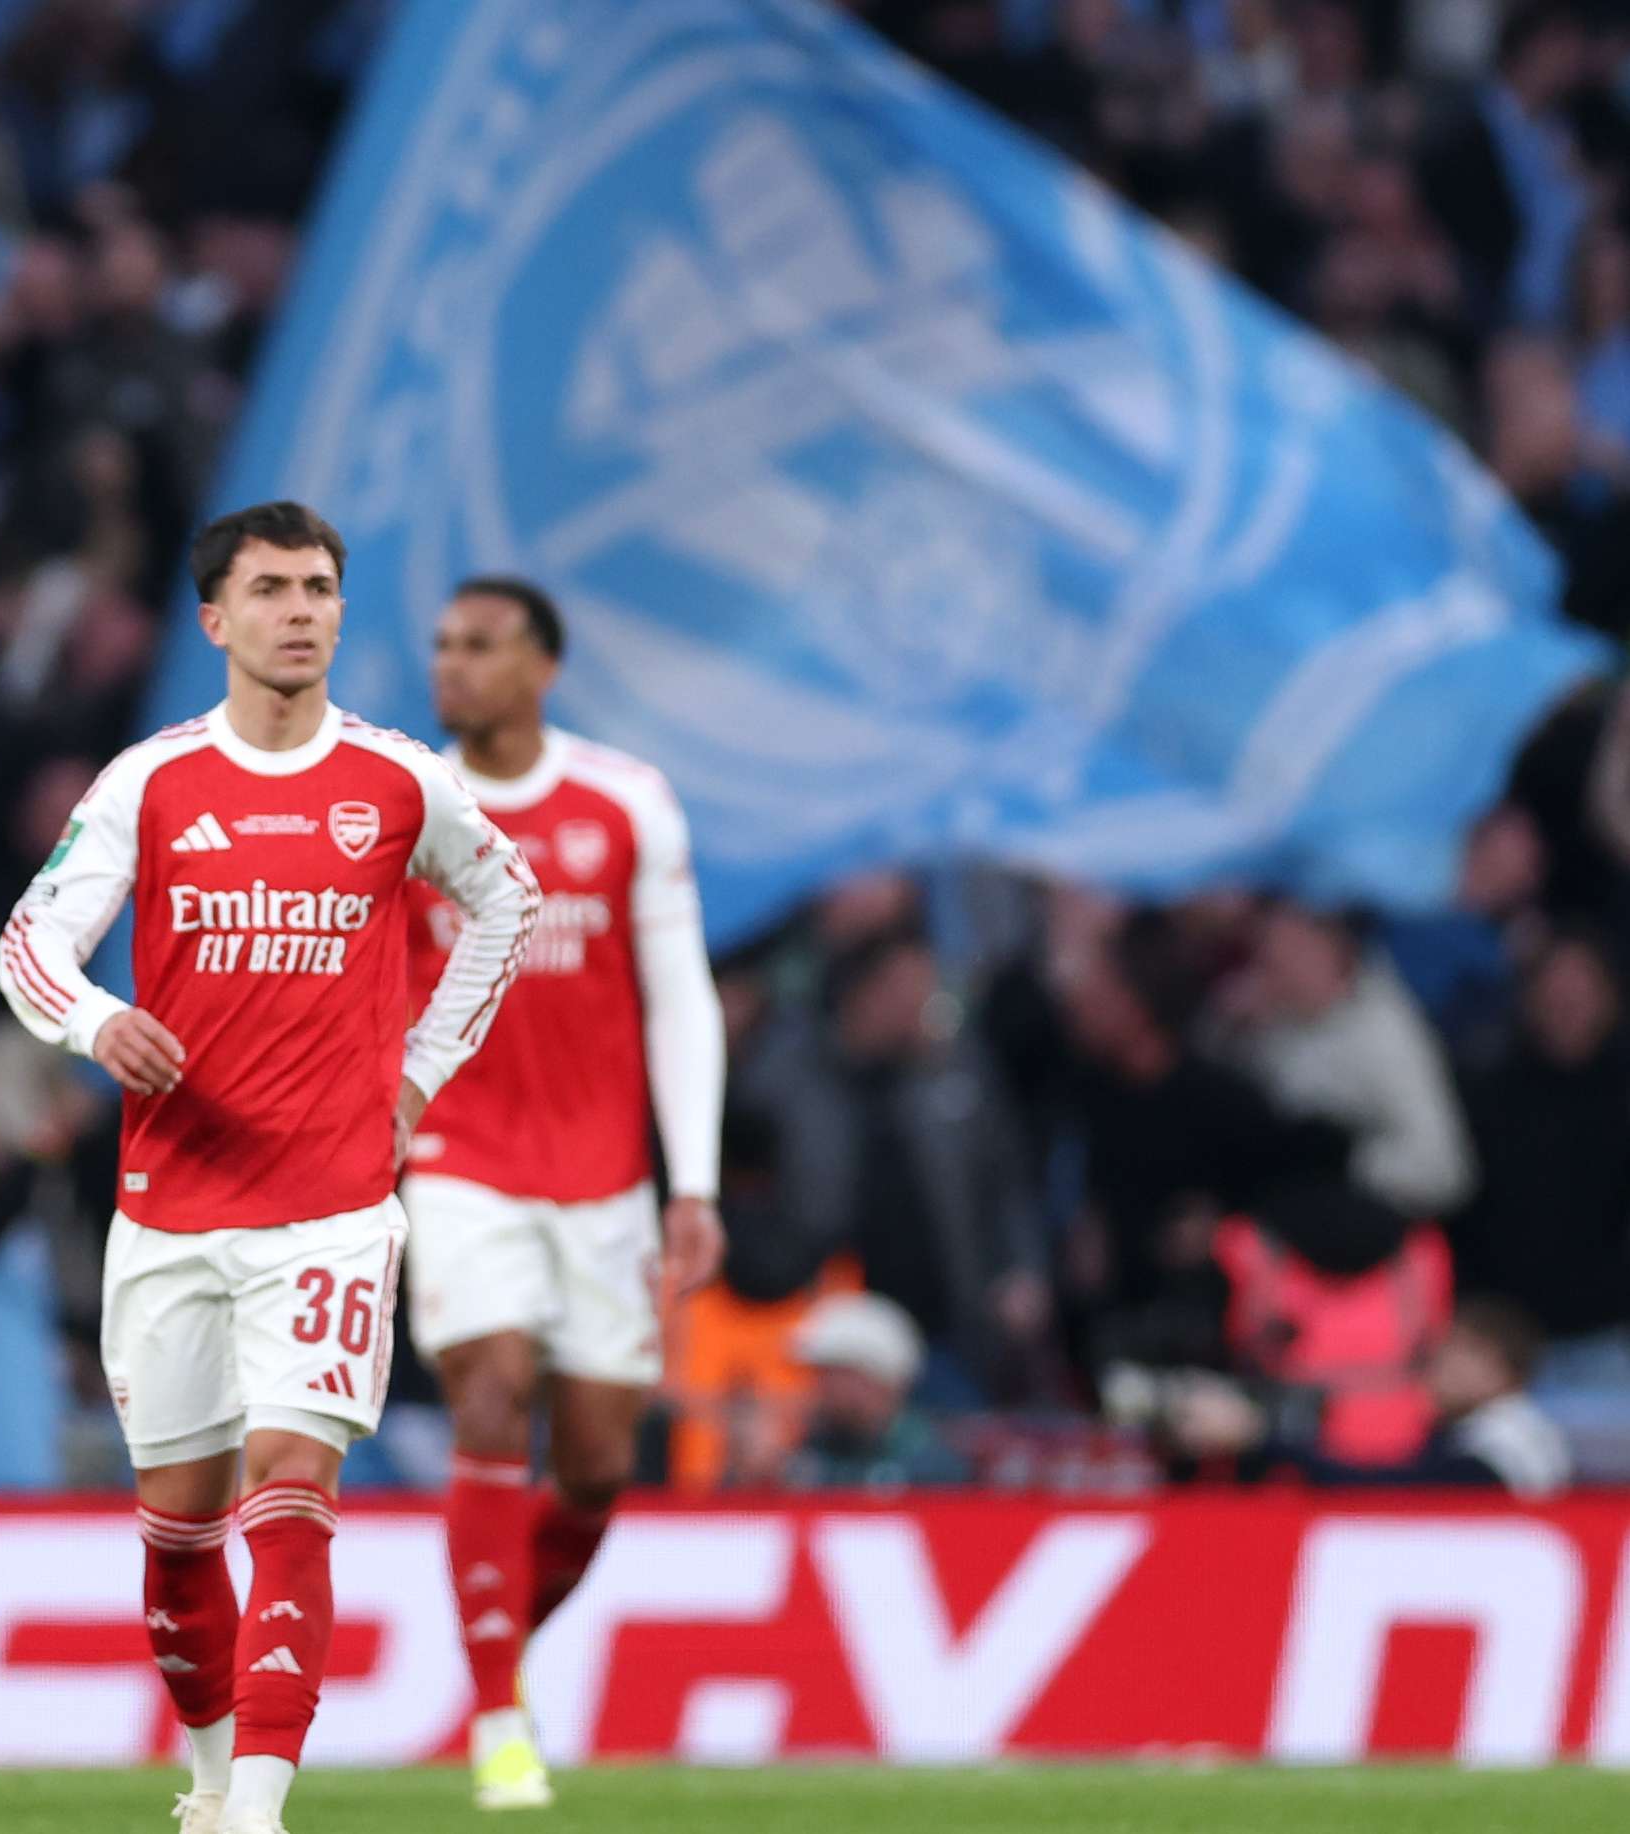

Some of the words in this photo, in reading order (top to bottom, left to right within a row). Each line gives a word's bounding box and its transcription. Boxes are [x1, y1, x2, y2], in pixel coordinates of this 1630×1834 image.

[168, 878, 374, 933] Emirates
[195, 933, 245, 973] FLY
[248, 933, 347, 975] BETTER
[291, 1266, 376, 1357] 36
